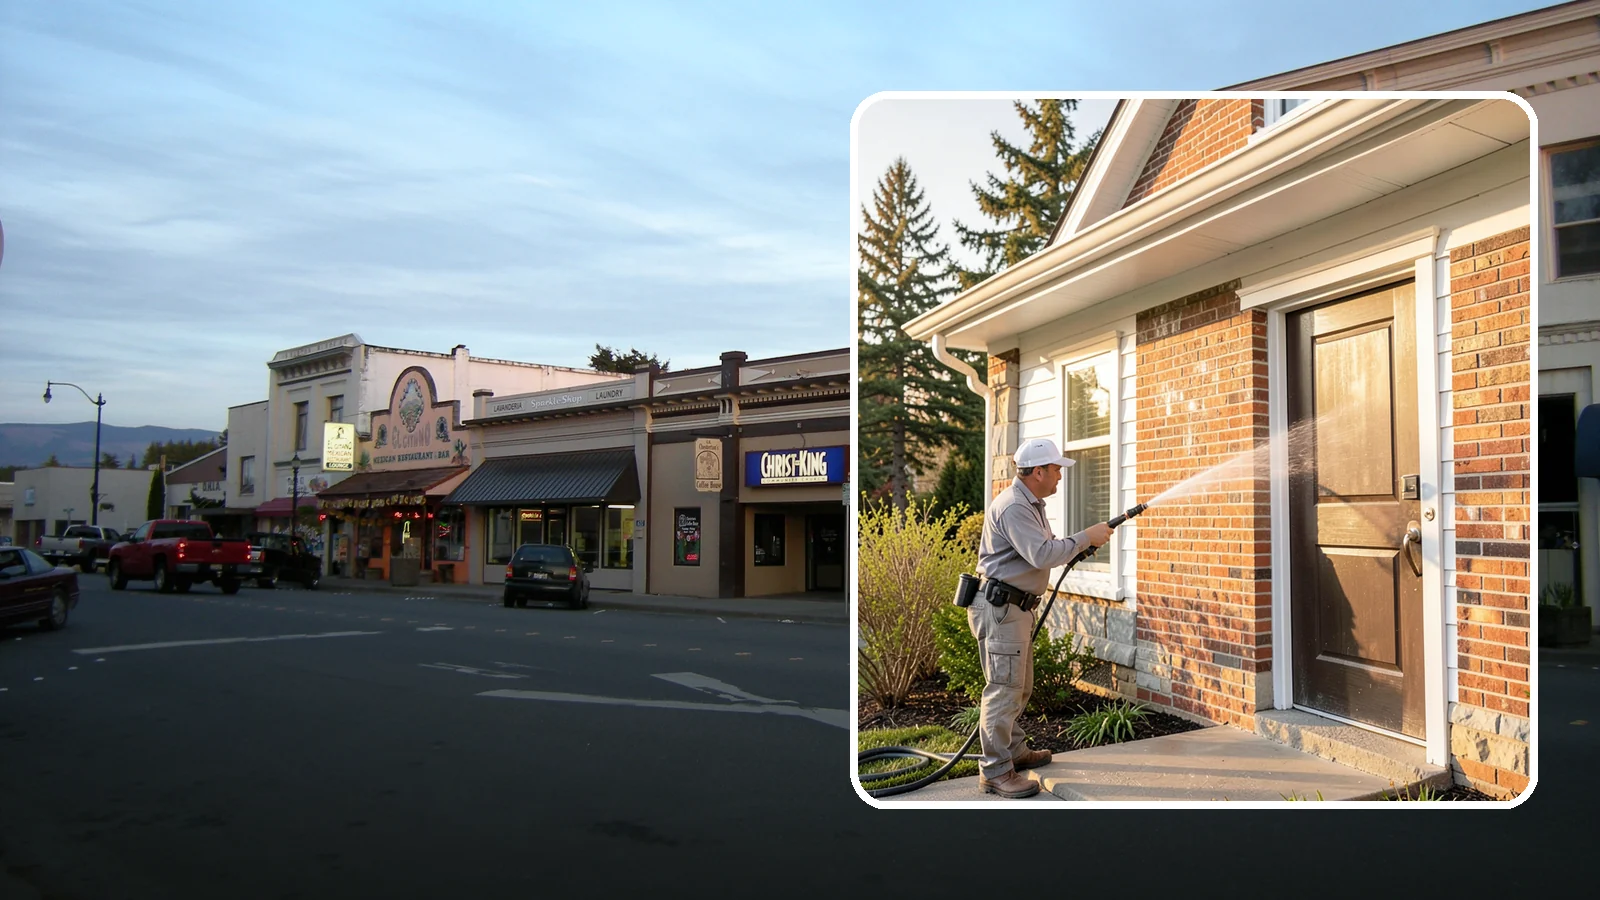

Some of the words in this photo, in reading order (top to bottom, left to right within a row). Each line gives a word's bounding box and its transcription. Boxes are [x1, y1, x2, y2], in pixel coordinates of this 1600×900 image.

[530, 396, 562, 409] Sparkle
[562, 394, 583, 405] Shop
[595, 388, 624, 400] LAUNDRY
[493, 402, 523, 413] LAVANDERIA
[391, 425, 402, 449] EL
[373, 454, 396, 465] MEXICAN
[398, 451, 433, 462] RESTAURANT
[438, 450, 450, 460] BAR
[760, 451, 798, 478] CHRIST
[799, 450, 827, 476] KING
